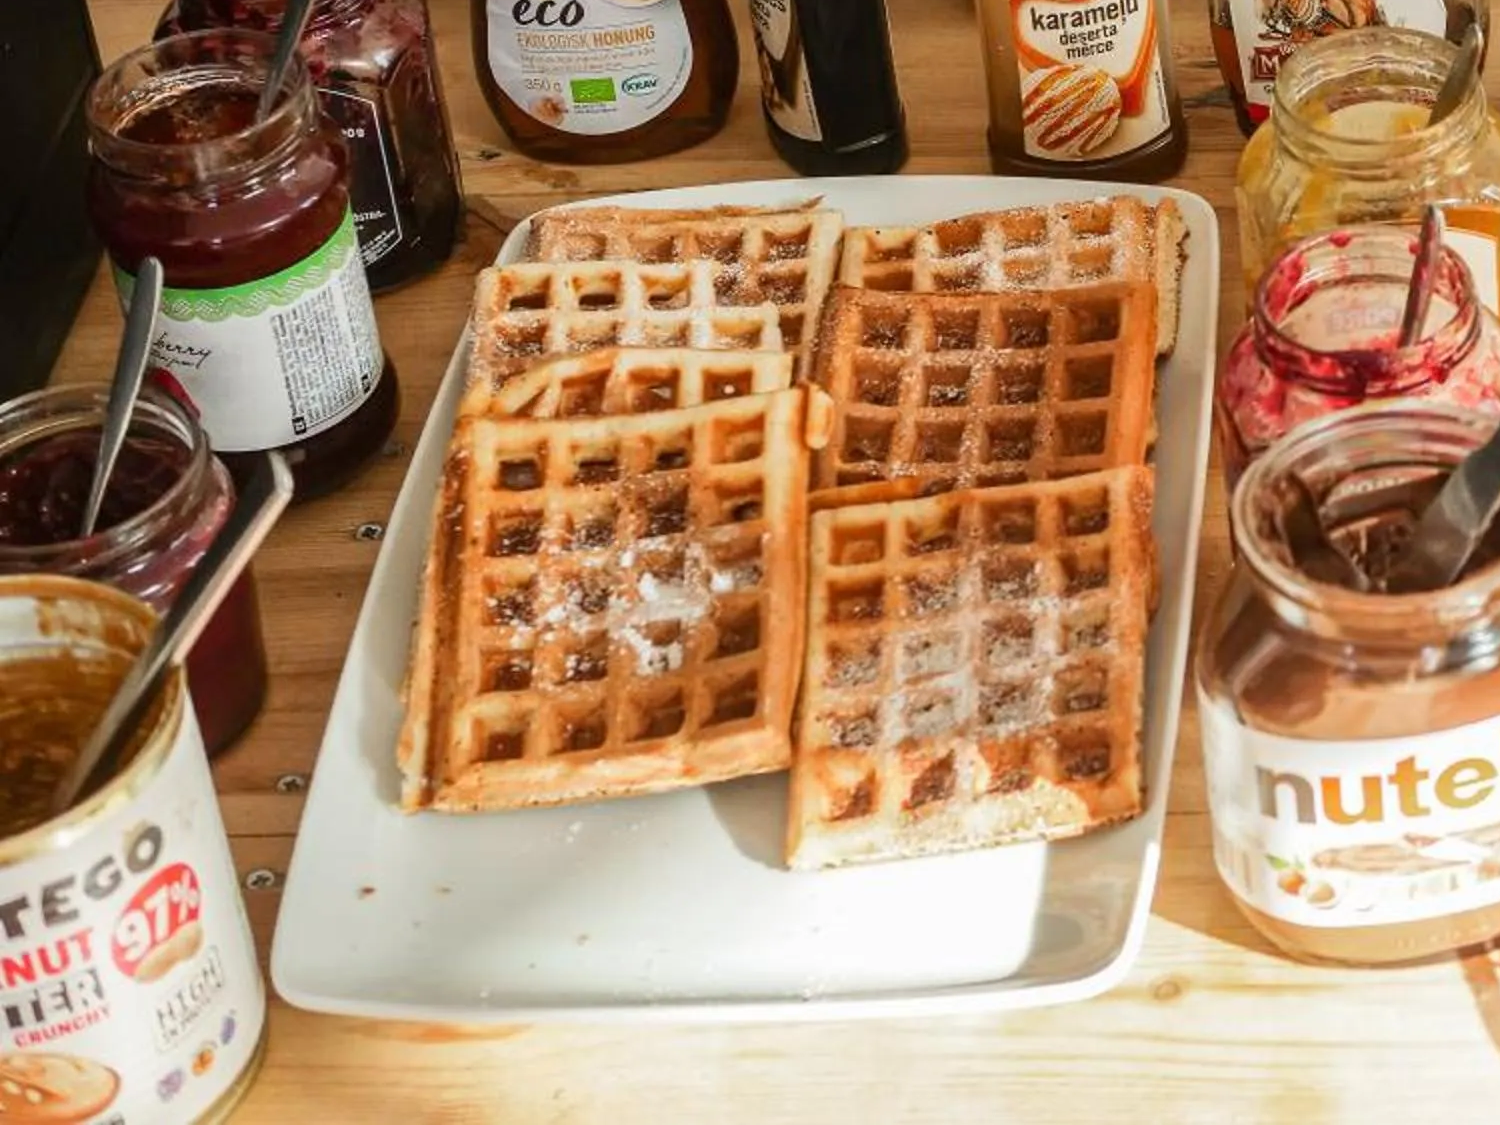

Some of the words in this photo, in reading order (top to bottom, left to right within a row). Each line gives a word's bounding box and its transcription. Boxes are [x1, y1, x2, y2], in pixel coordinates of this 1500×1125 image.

[593, 26, 656, 47] HONUNG
[1059, 24, 1118, 46] deserta
[152, 330, 212, 369] berry
[0, 824, 163, 940] TEGO
[115, 869, 200, 962] 97%
[0, 926, 95, 989] NUT
